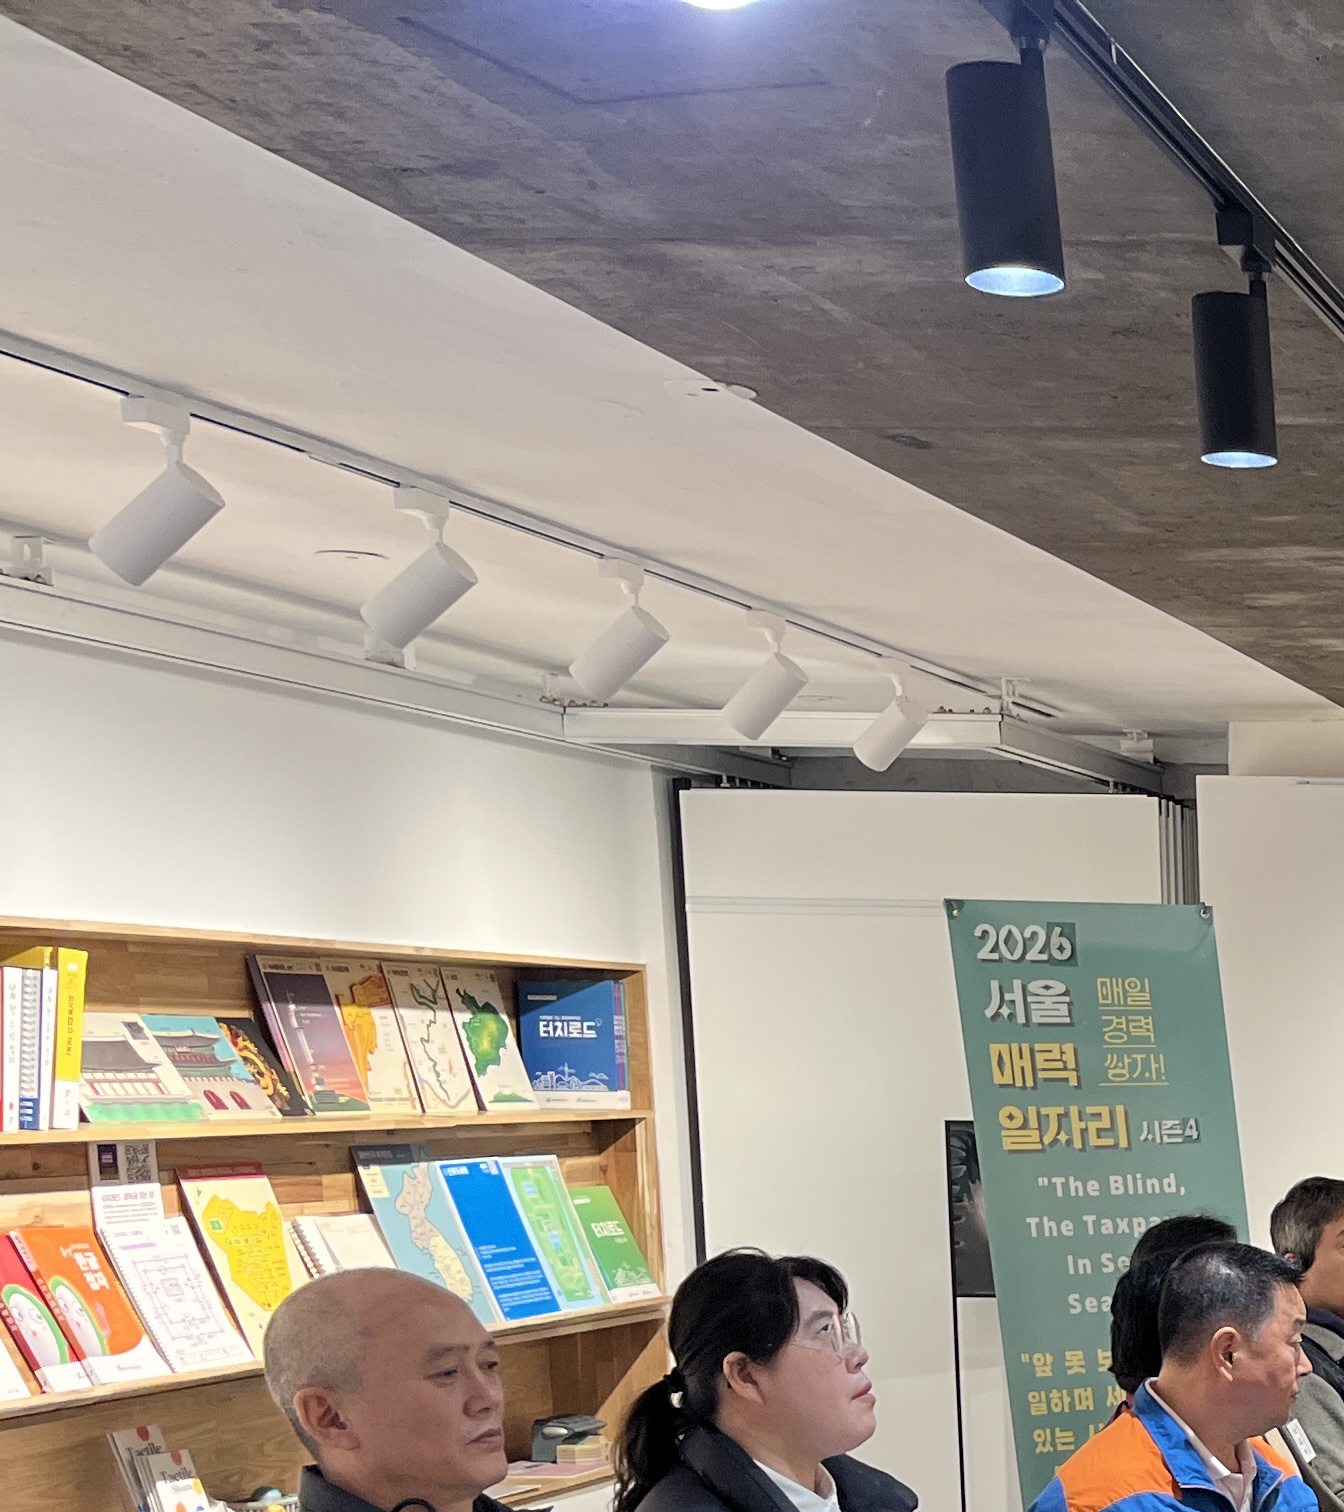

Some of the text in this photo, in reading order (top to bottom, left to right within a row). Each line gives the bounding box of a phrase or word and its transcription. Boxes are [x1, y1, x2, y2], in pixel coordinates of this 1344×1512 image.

[973, 923, 1073, 962] 2026
[983, 979, 1071, 1024] 서울
[1096, 977, 1152, 1006] 매일
[1100, 1015, 1156, 1043] 경력
[989, 1043, 1079, 1088] 매력
[998, 1104, 1199, 1151] 일자리 시즌4
[1037, 1172, 1187, 1198] "The Blind,
[1025, 1215, 1075, 1238] The
[1066, 1254, 1093, 1275] In
[1020, 1351, 1054, 1377] "앞
[1064, 1350, 1087, 1376] 못
[1027, 1386, 1095, 1416] 일하며
[1032, 1426, 1076, 1454] 있는
